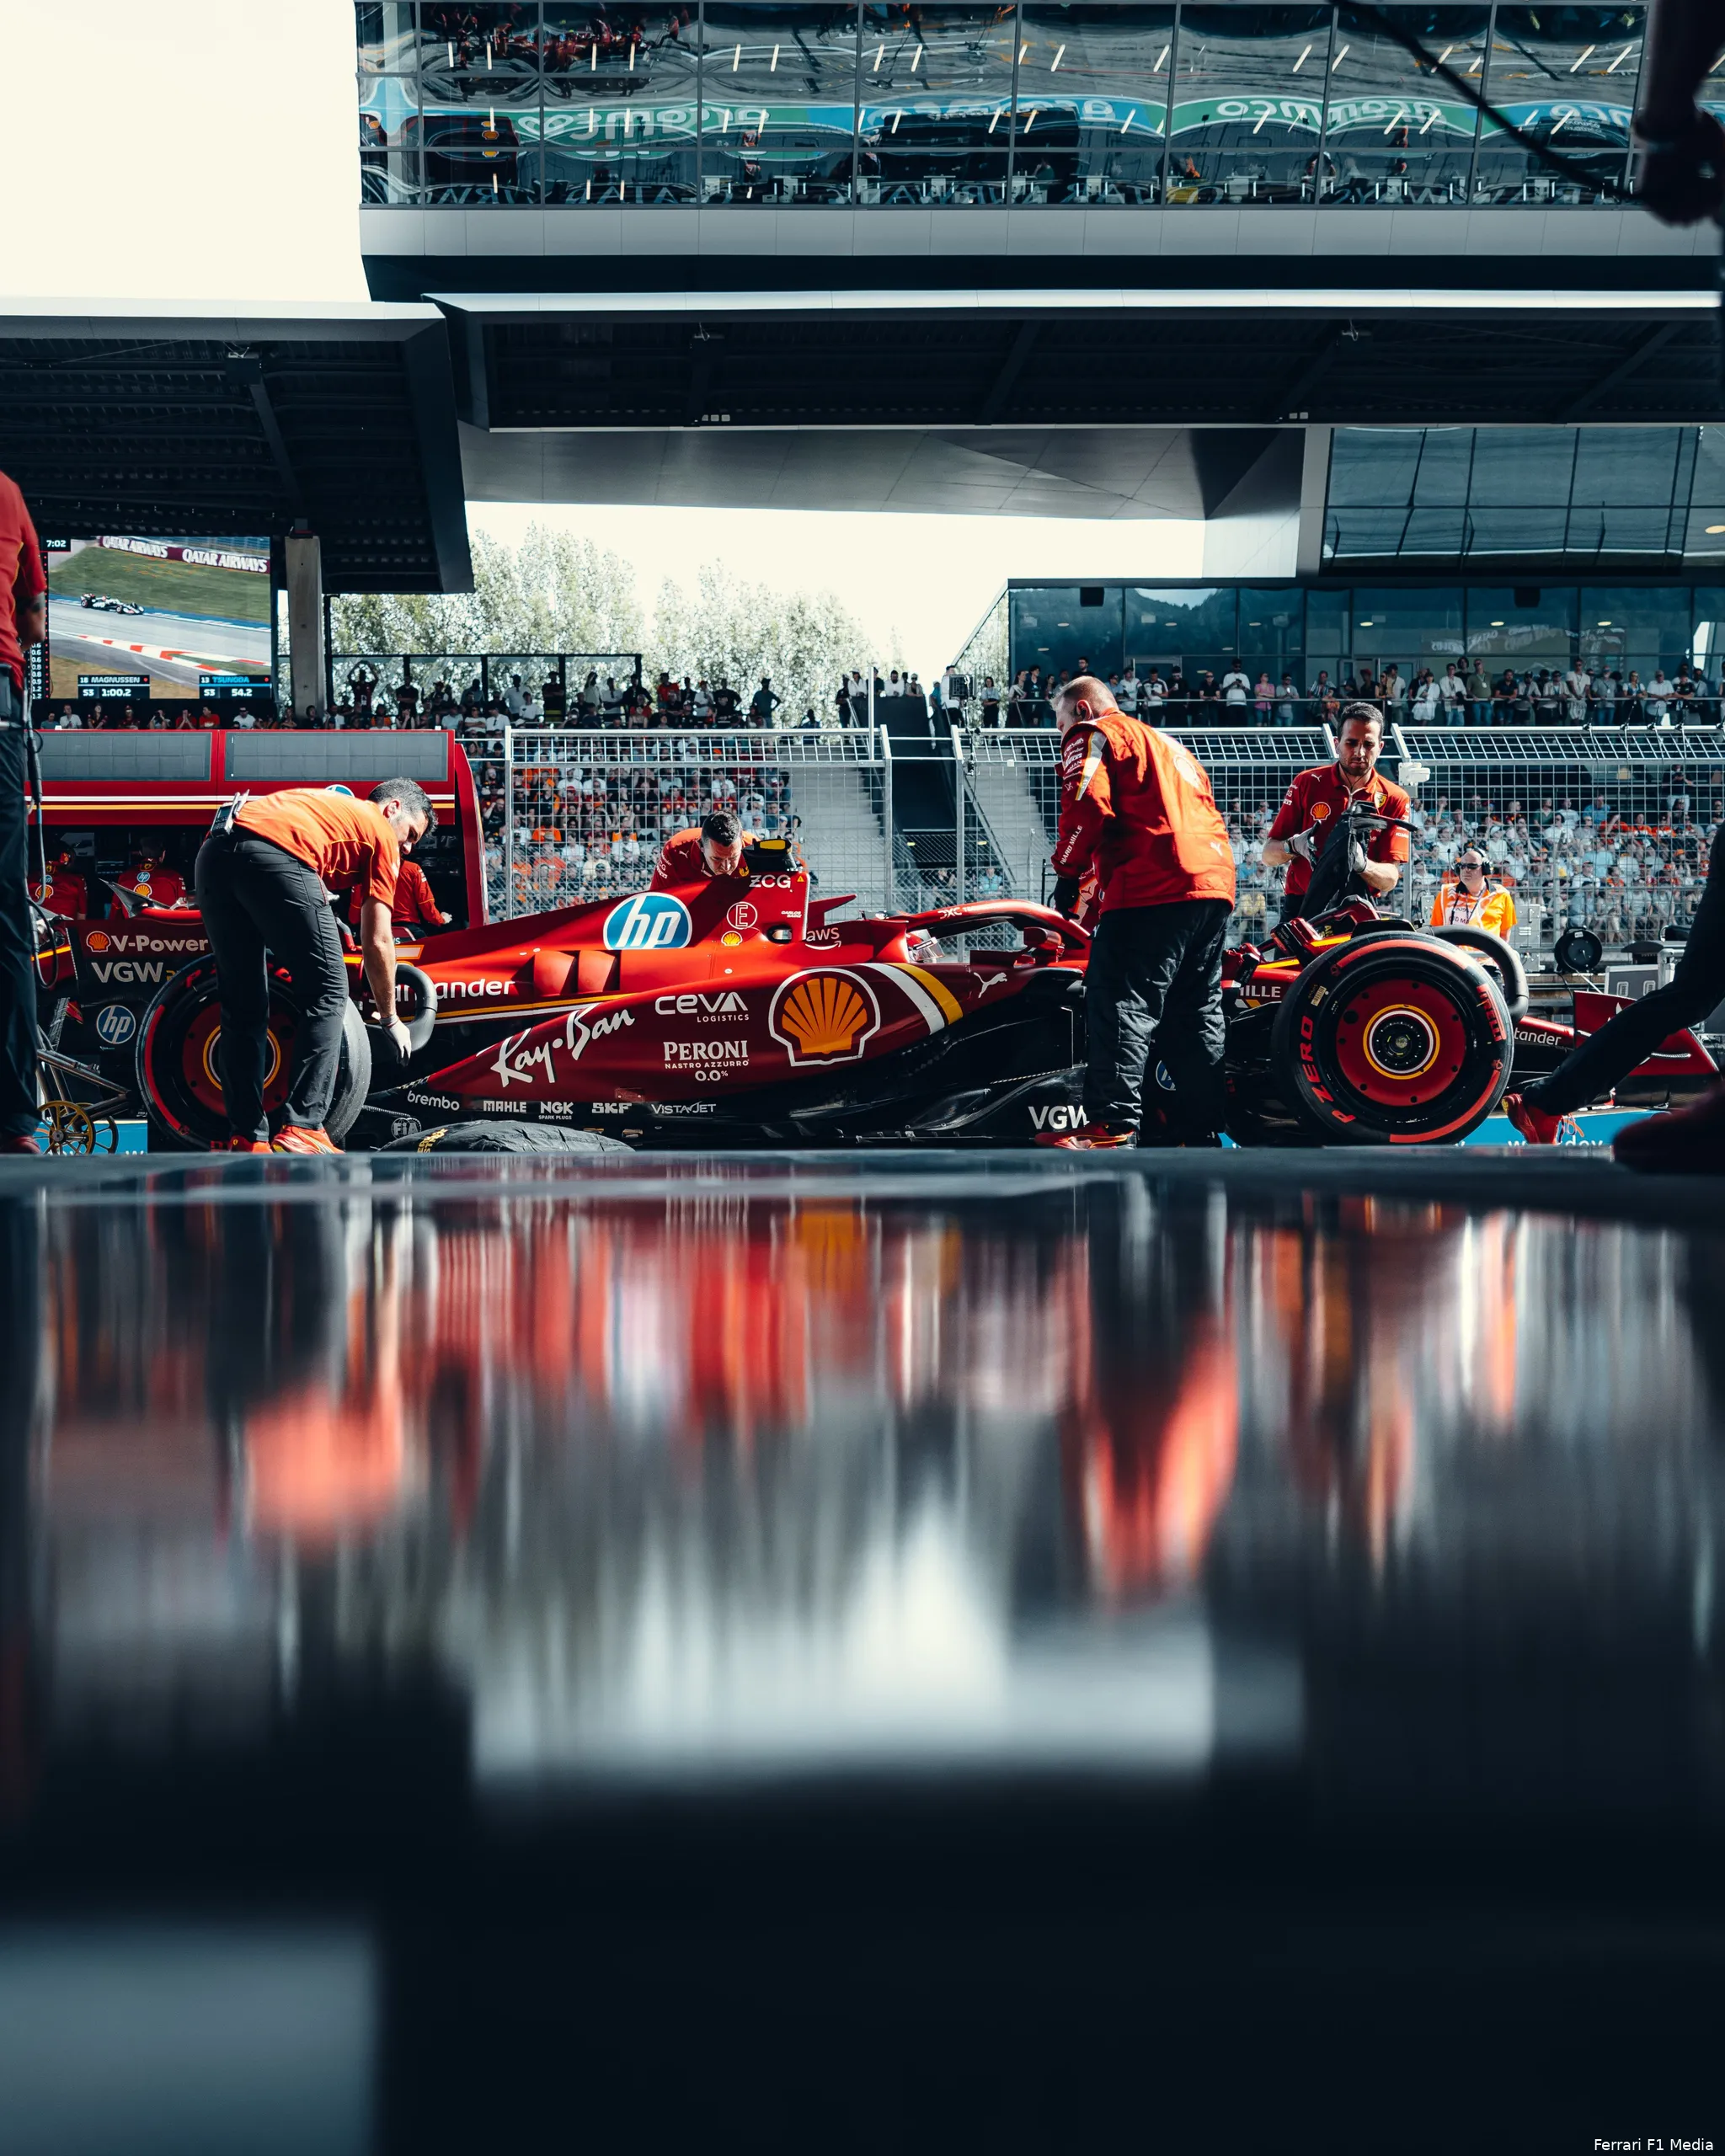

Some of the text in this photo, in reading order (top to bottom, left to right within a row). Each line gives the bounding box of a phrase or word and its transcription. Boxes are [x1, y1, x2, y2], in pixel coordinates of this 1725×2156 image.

[128, 538, 168, 558] AIRWAYS
[182, 548, 268, 573] QATAR AIRWAYS
[83, 688, 131, 696] S3 1:00.2
[204, 688, 252, 696] S3 54.2
[1069, 825, 1083, 846] MILLE
[138, 872, 149, 883] hp
[749, 874, 791, 889] ZCG
[937, 907, 963, 920] DXC
[615, 894, 682, 949] hp
[806, 927, 840, 942] aws
[110, 935, 209, 953] V-Power
[91, 962, 163, 983] VGW
[102, 1006, 131, 1044] hp
[697, 1014, 750, 1022] LOGISTICS
[1514, 1027, 1562, 1046] tander
[663, 1040, 749, 1061] PERONI
[704, 1059, 750, 1068] AZZURRO
[1300, 1016, 1334, 1104] ZERO
[695, 1070, 729, 1081] 0.0%
[407, 1090, 460, 1112] brembo
[483, 1100, 527, 1113] MAHLE
[540, 1102, 574, 1114] NGK
[592, 1102, 632, 1114] SKF
